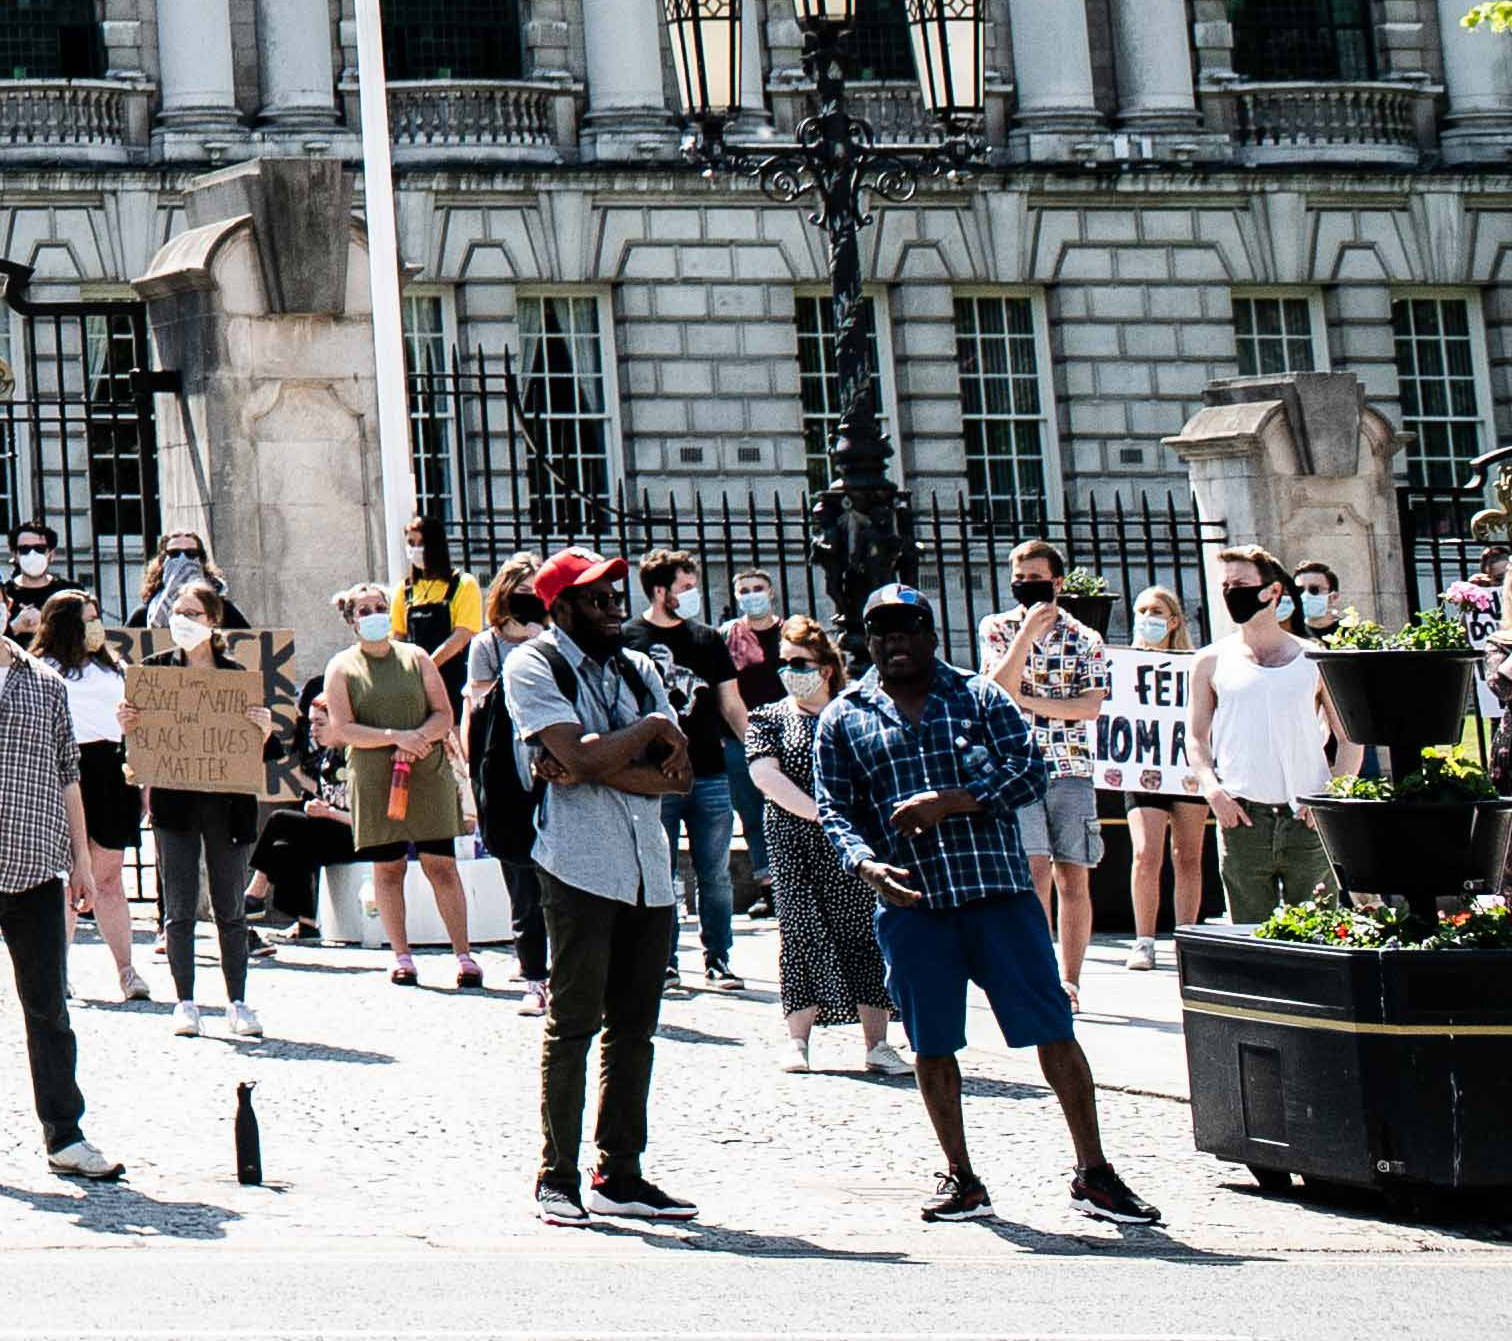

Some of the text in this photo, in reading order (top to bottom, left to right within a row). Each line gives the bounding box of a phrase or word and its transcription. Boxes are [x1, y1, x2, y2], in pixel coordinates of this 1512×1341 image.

[135, 670, 162, 690] All
[133, 726, 250, 755] BLACK LIVES
[154, 756, 230, 782] MATTER
